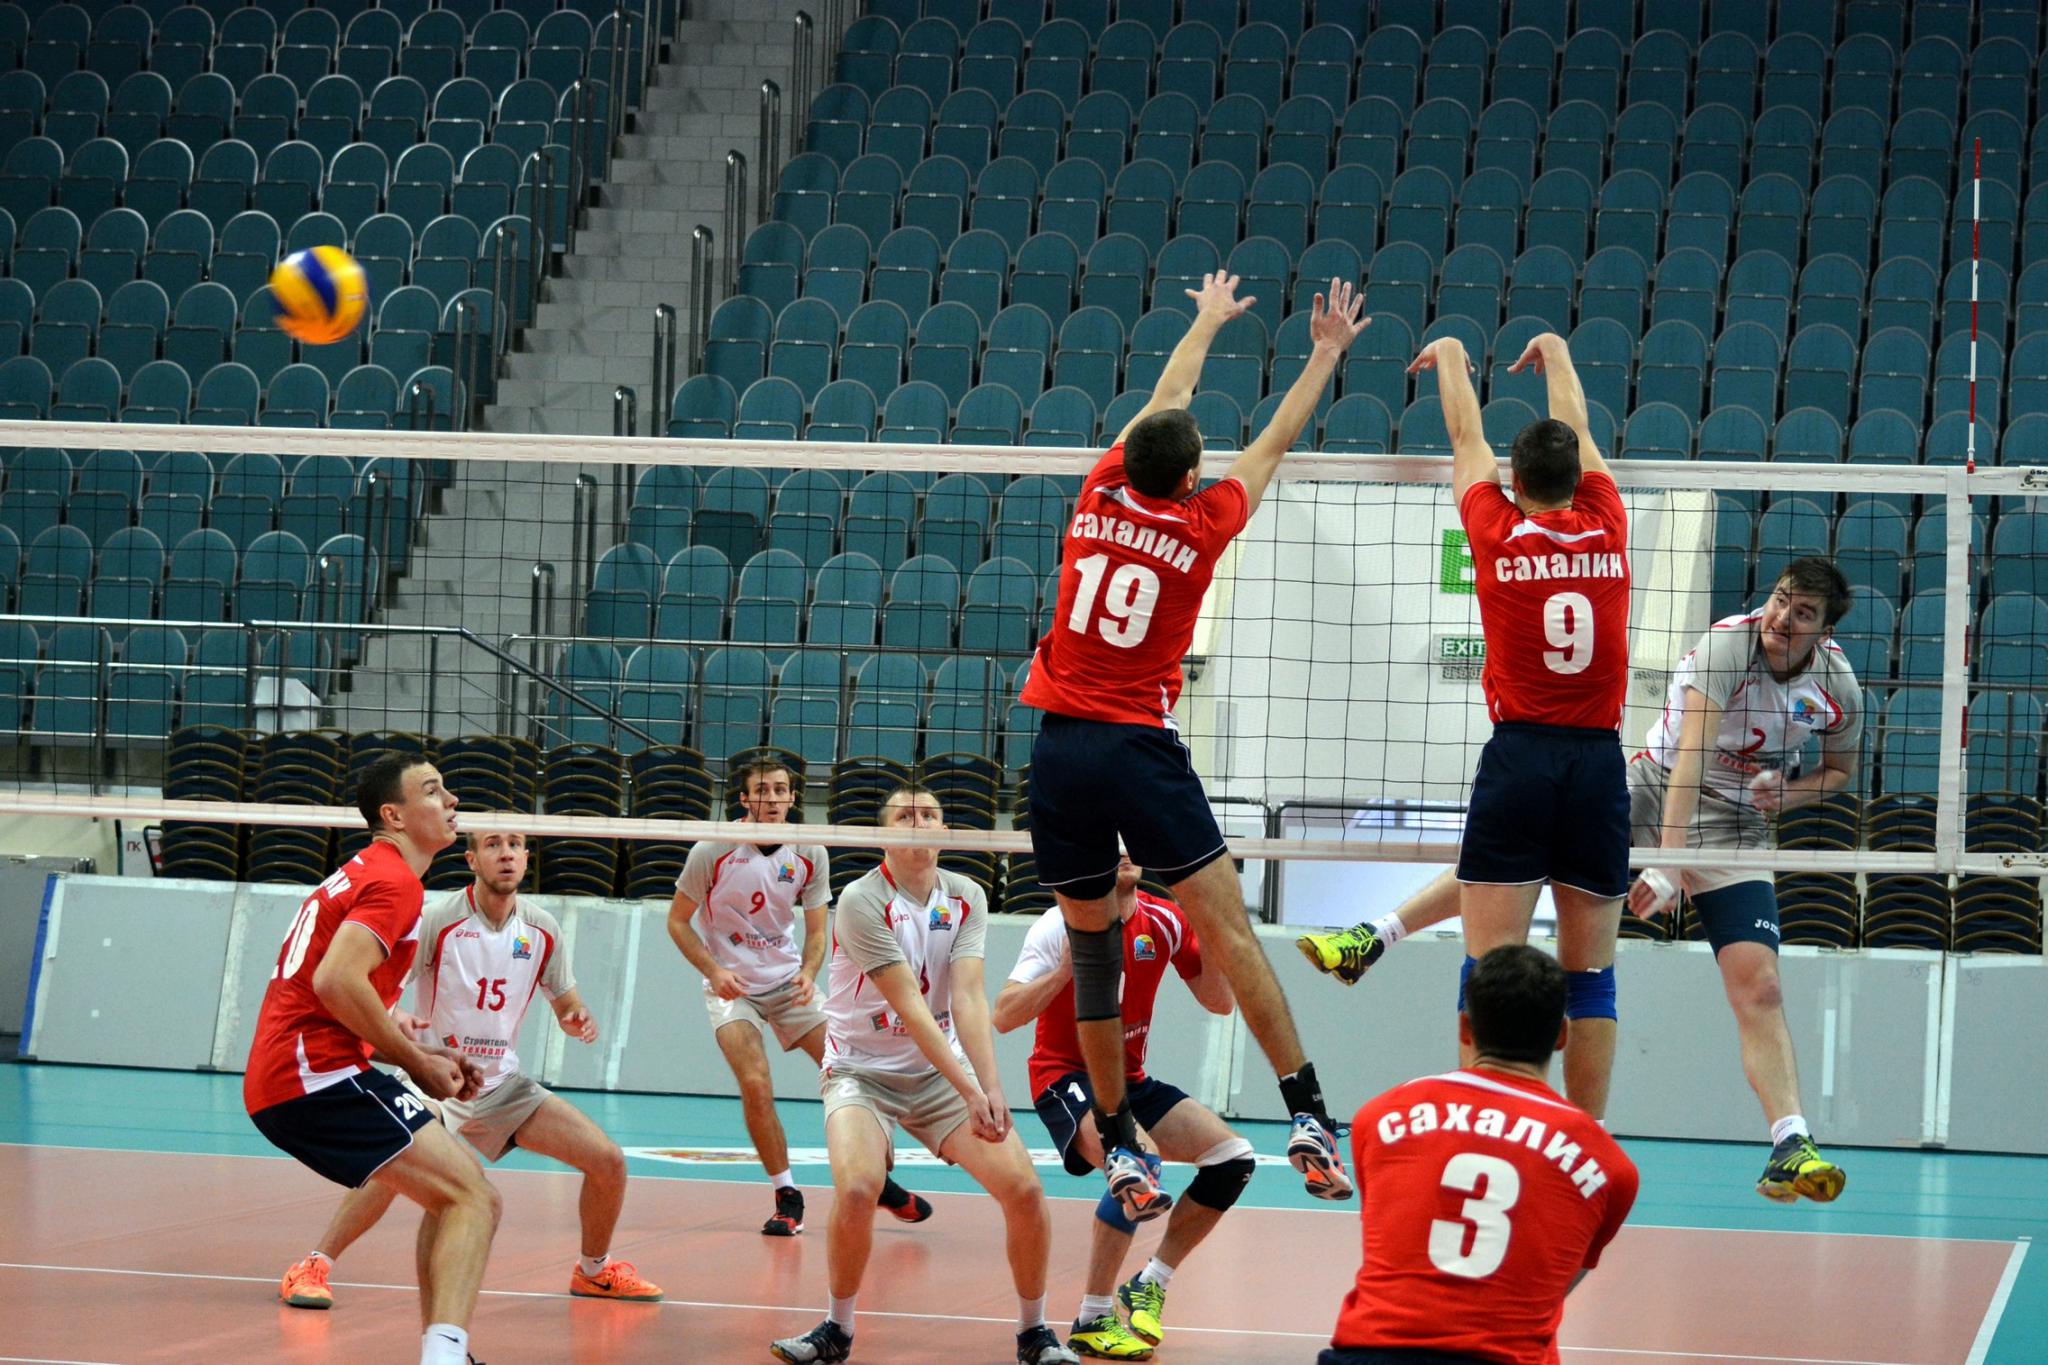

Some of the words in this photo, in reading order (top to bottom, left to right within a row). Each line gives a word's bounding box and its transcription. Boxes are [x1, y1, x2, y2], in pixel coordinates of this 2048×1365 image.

[1072, 512, 1198, 574] сахалин
[1495, 552, 1624, 582] сахалин
[1068, 552, 1161, 648] 19
[1443, 640, 1485, 656] EXIT
[1543, 592, 1594, 674] 9
[1737, 727, 1766, 756] 2
[748, 891, 766, 915] 9
[476, 977, 507, 1012] 15
[394, 1093, 425, 1120] 20
[1067, 1081, 1087, 1103] 1
[1377, 1102, 1608, 1199] сахалин
[1427, 1153, 1520, 1279] 3
